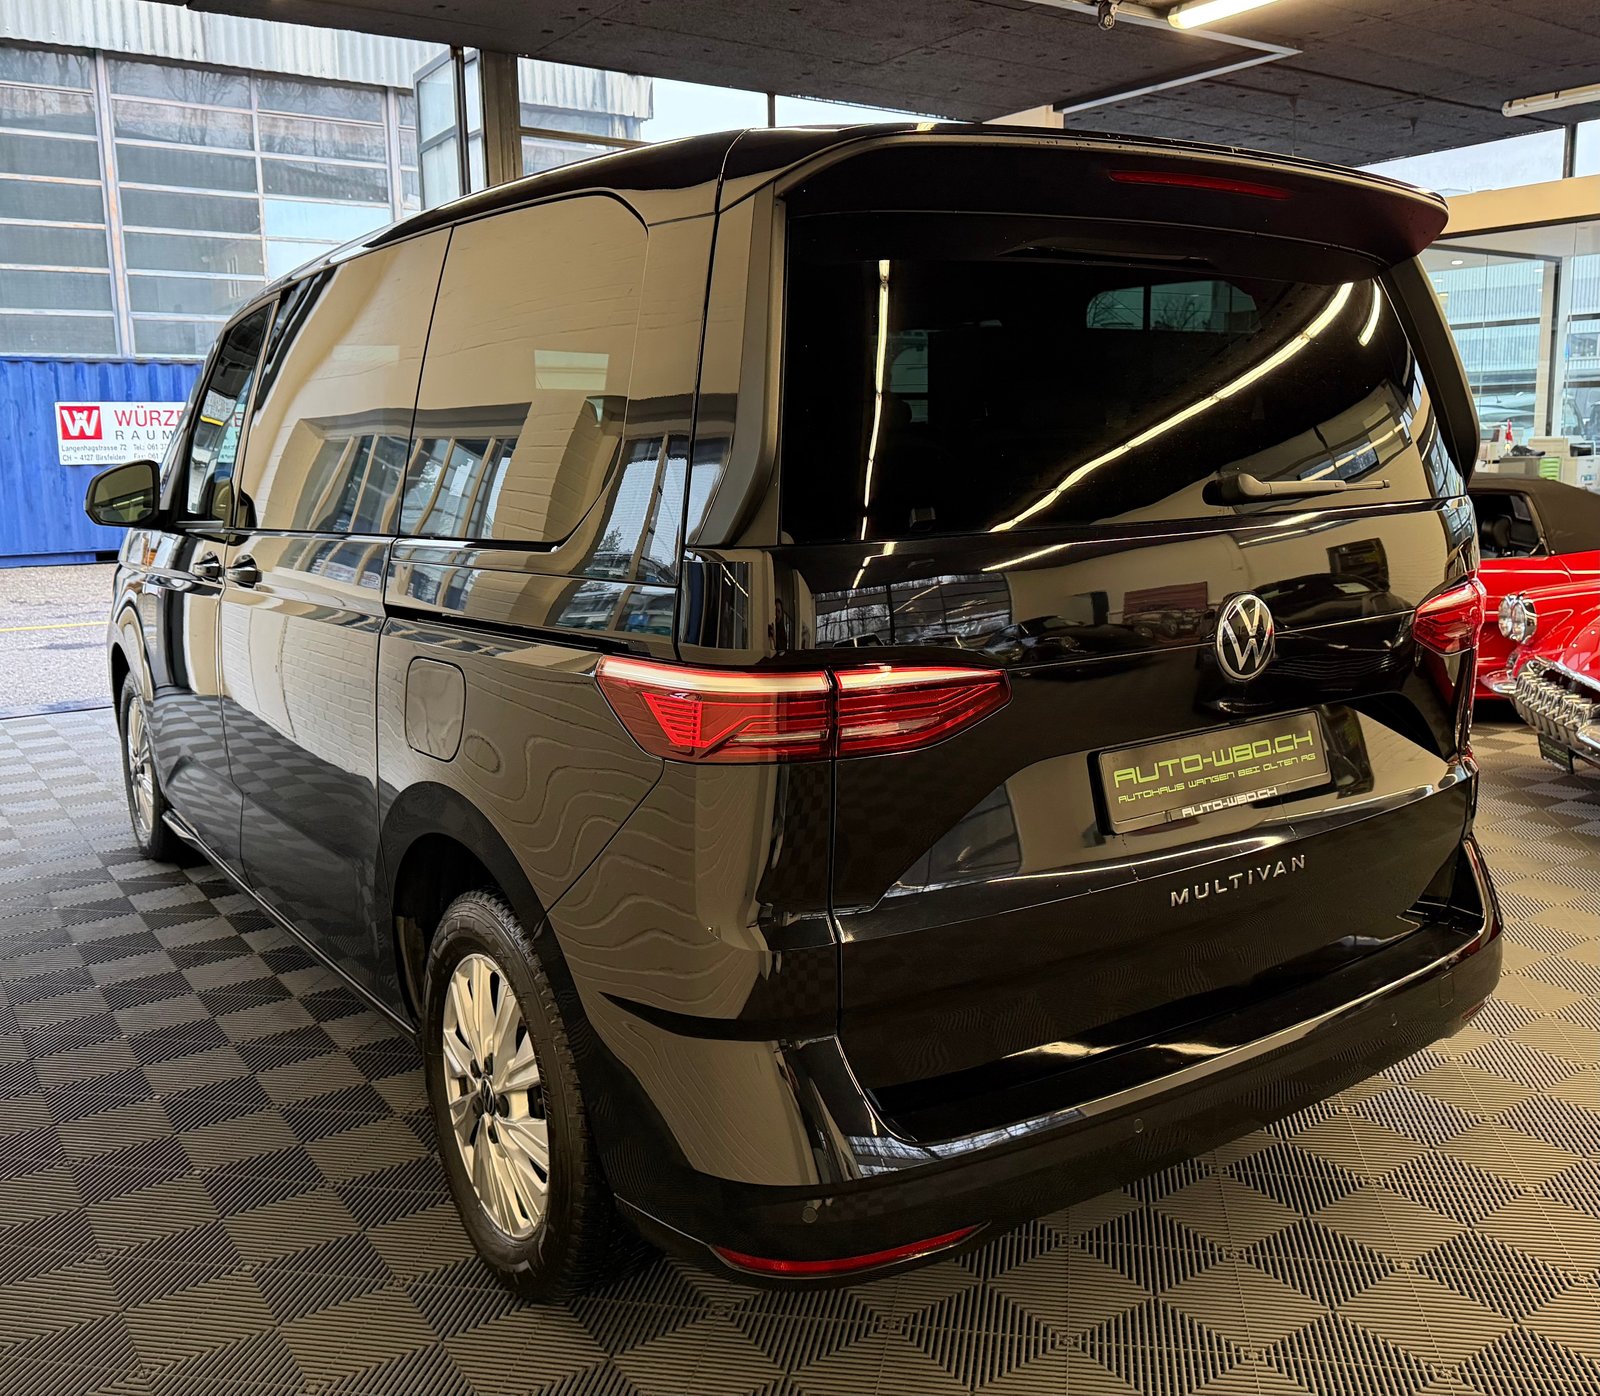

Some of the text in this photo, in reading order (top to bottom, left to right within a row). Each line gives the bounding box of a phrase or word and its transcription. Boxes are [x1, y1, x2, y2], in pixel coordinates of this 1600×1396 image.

[80, 453, 94, 461] 4127
[1118, 752, 1316, 804] AUTOHAUS WANGEN BEI OLTEN AG
[1170, 854, 1306, 907] MULTIVAN
